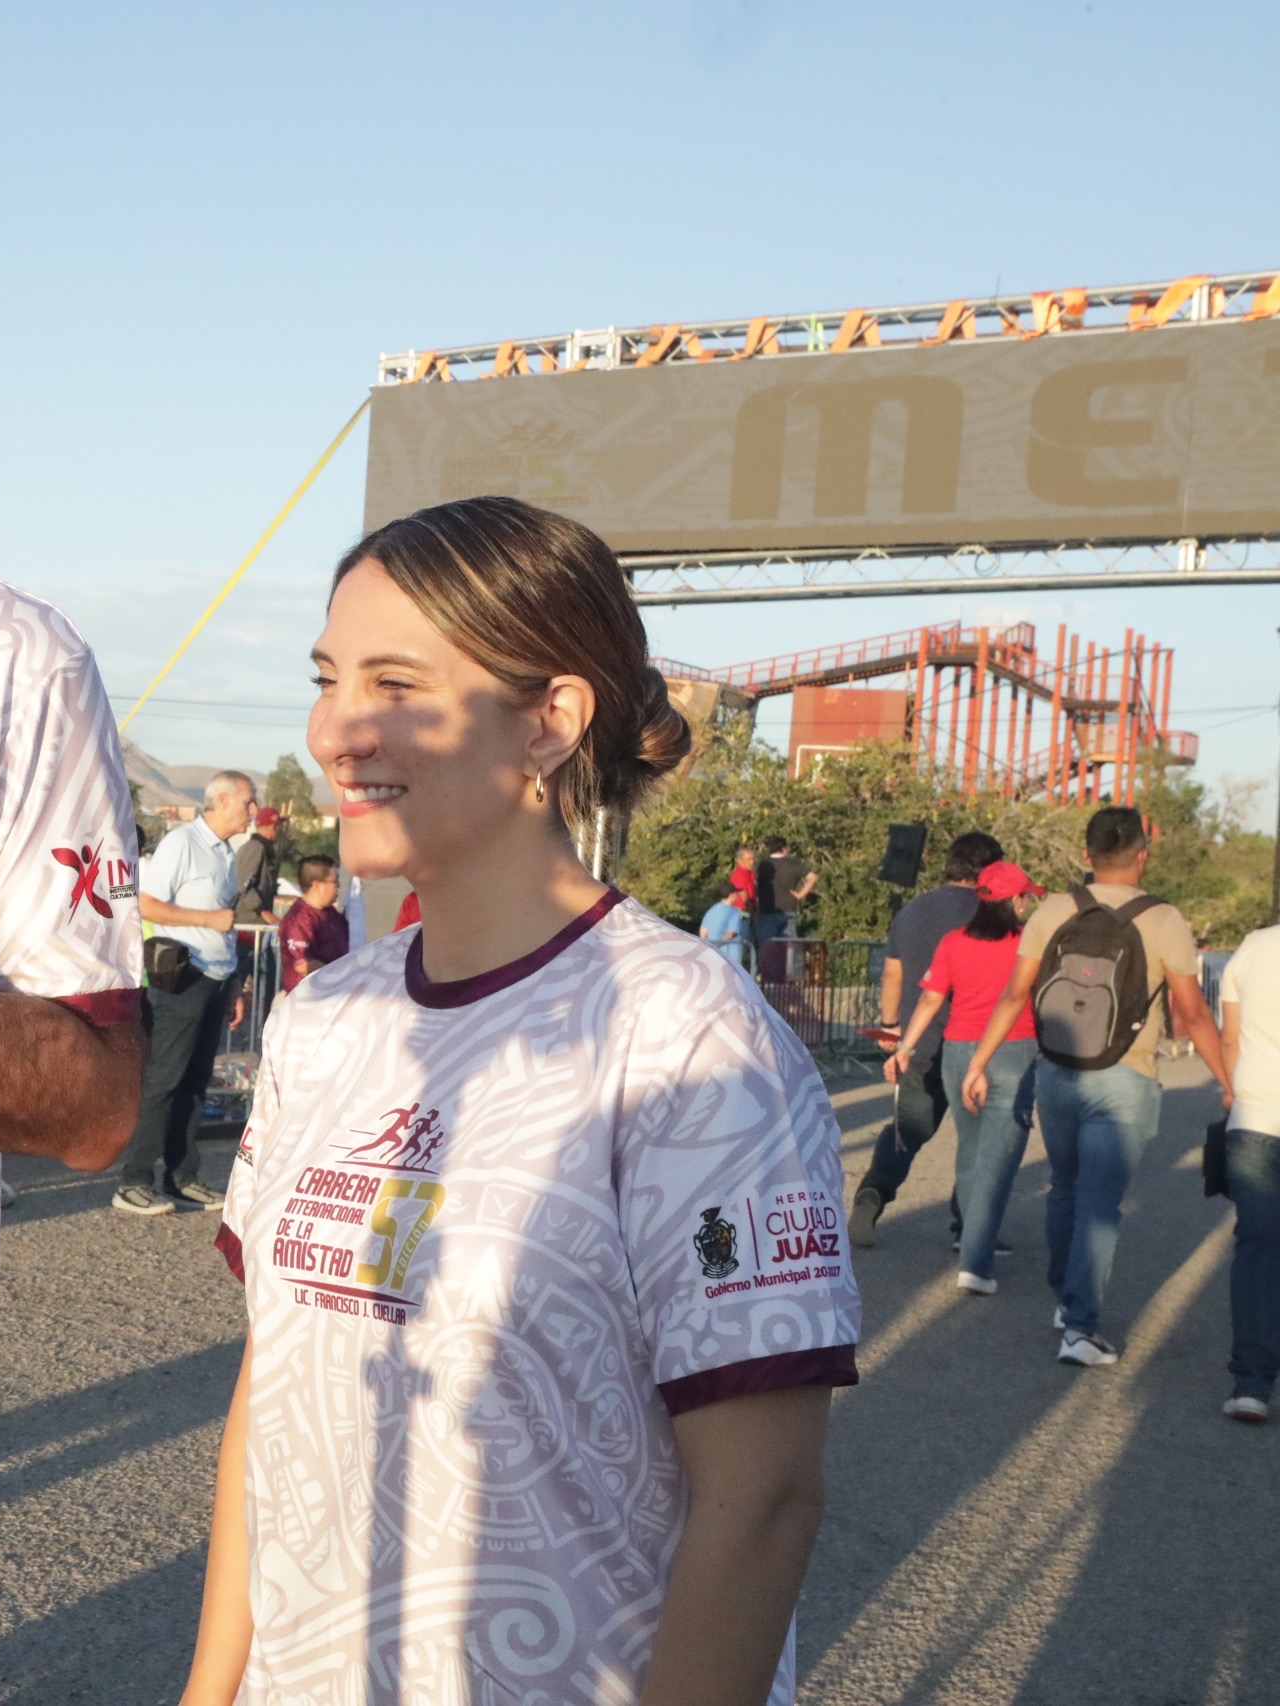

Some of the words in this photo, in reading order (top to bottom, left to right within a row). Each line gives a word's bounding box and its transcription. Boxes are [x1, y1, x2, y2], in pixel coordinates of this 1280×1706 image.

[729, 347, 1280, 521] ME
[295, 1166, 382, 1206] CARRERA
[276, 1217, 292, 1238] DE
[296, 1220, 315, 1240] LA
[284, 1197, 365, 1226] INTERNACIONAL
[355, 1178, 447, 1291] 57
[272, 1238, 354, 1278] AMISTAD
[704, 1279, 751, 1300] Gobierno
[753, 1266, 811, 1288] Municipal
[294, 1288, 311, 1306] LIC.
[314, 1291, 359, 1317] FRANCISCO
[363, 1302, 370, 1318] J.
[372, 1302, 407, 1327] CUELLAR
